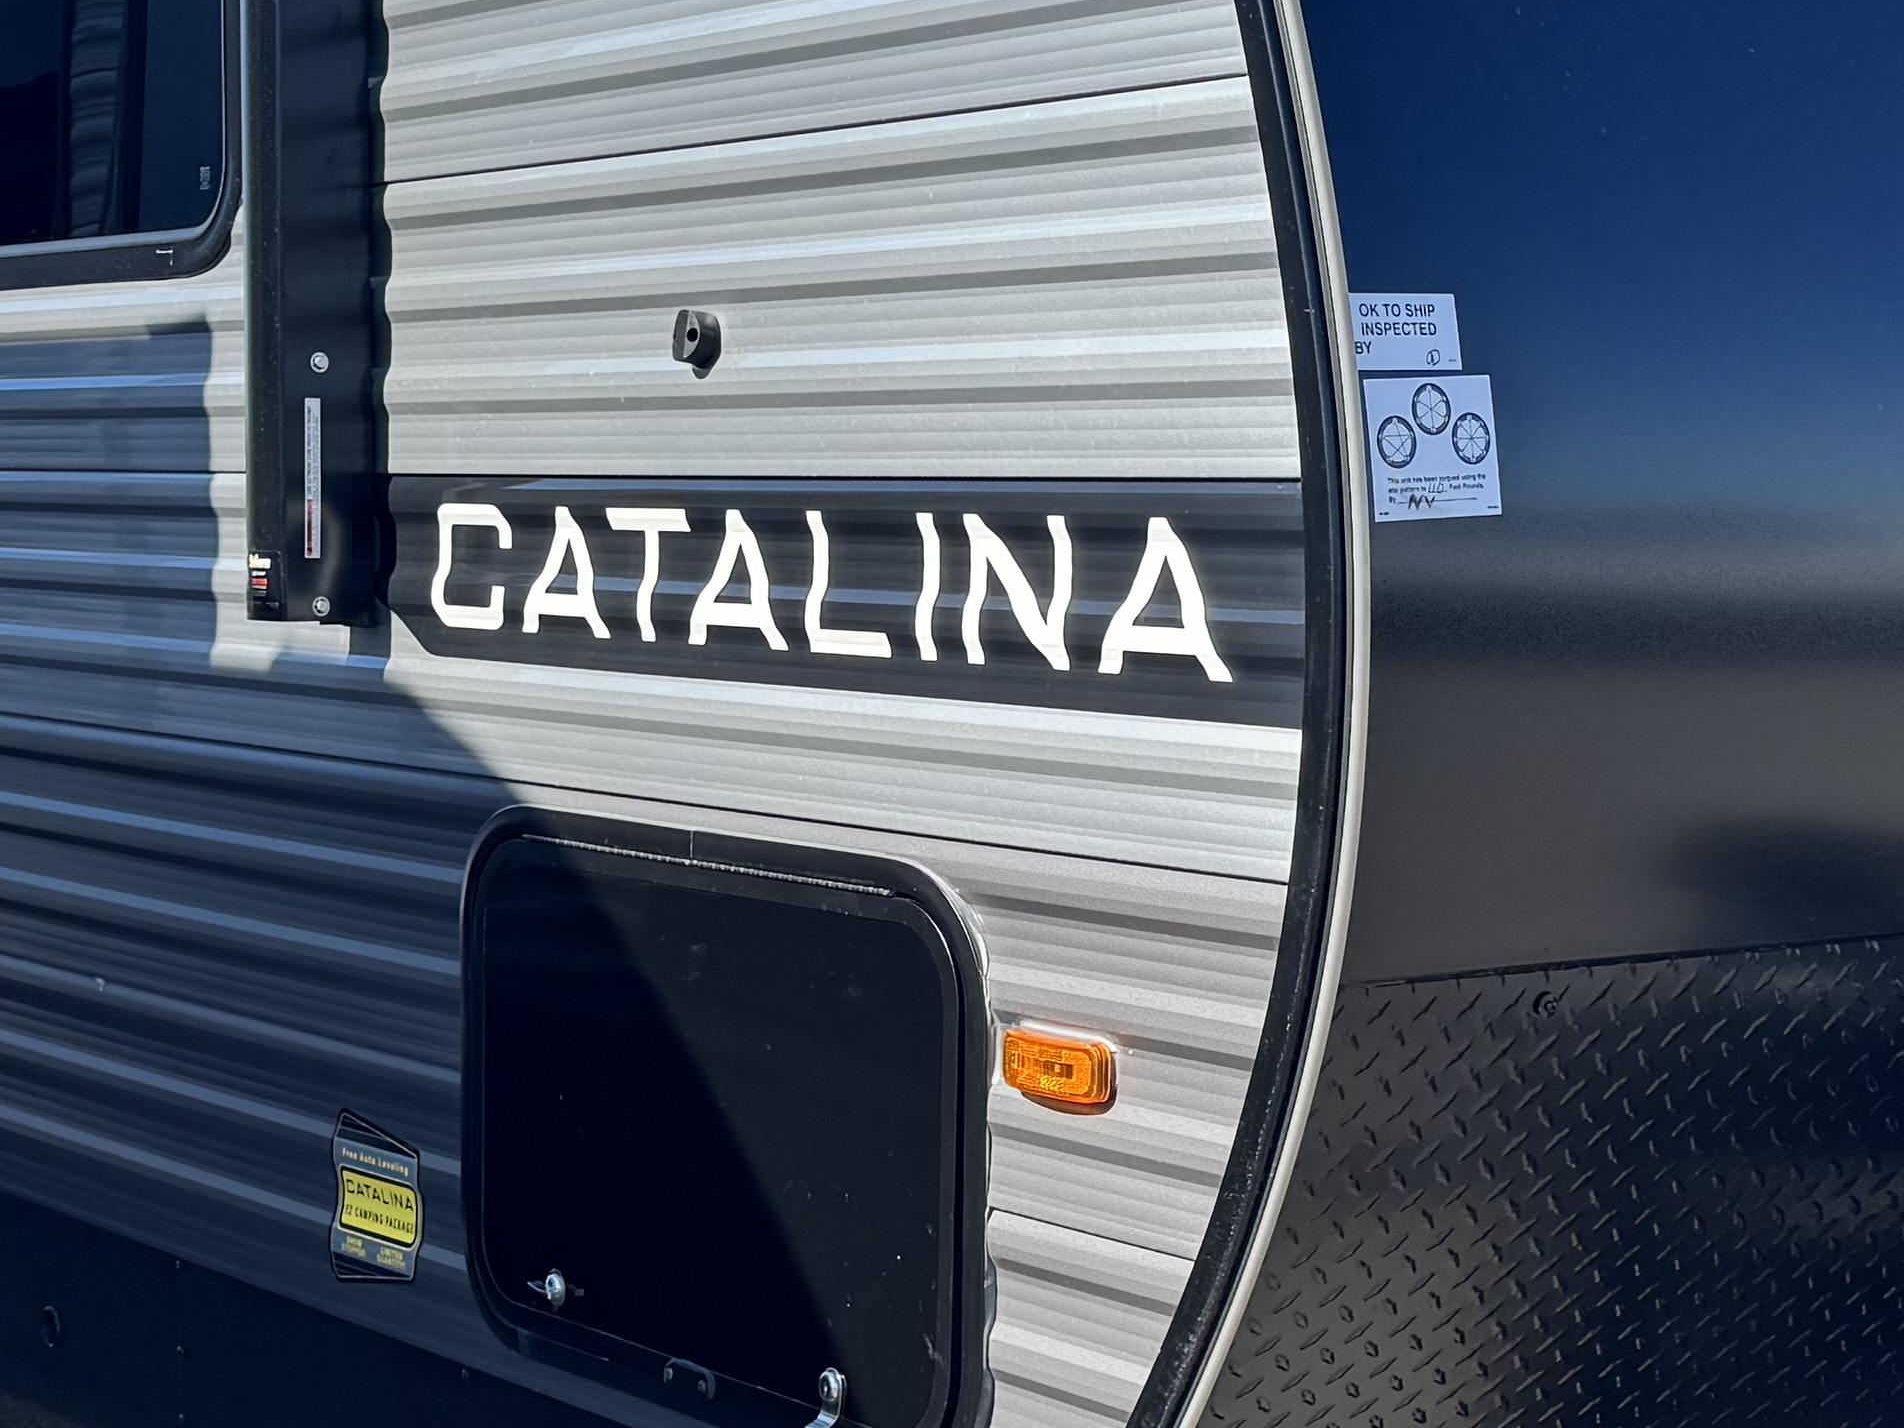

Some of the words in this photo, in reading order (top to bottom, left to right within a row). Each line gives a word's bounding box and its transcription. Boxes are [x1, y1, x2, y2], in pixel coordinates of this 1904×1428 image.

[1359, 303, 1379, 317] OK
[1382, 303, 1401, 317] TO
[1405, 303, 1435, 317] SHIP
[1361, 322, 1437, 336] INSPECTED
[1354, 340, 1372, 354] BY
[429, 502, 1234, 684] CATALINA
[346, 1179, 414, 1212] CATALINA
[355, 1206, 383, 1225] CAMPING
[386, 1215, 414, 1234] PACKAGE
